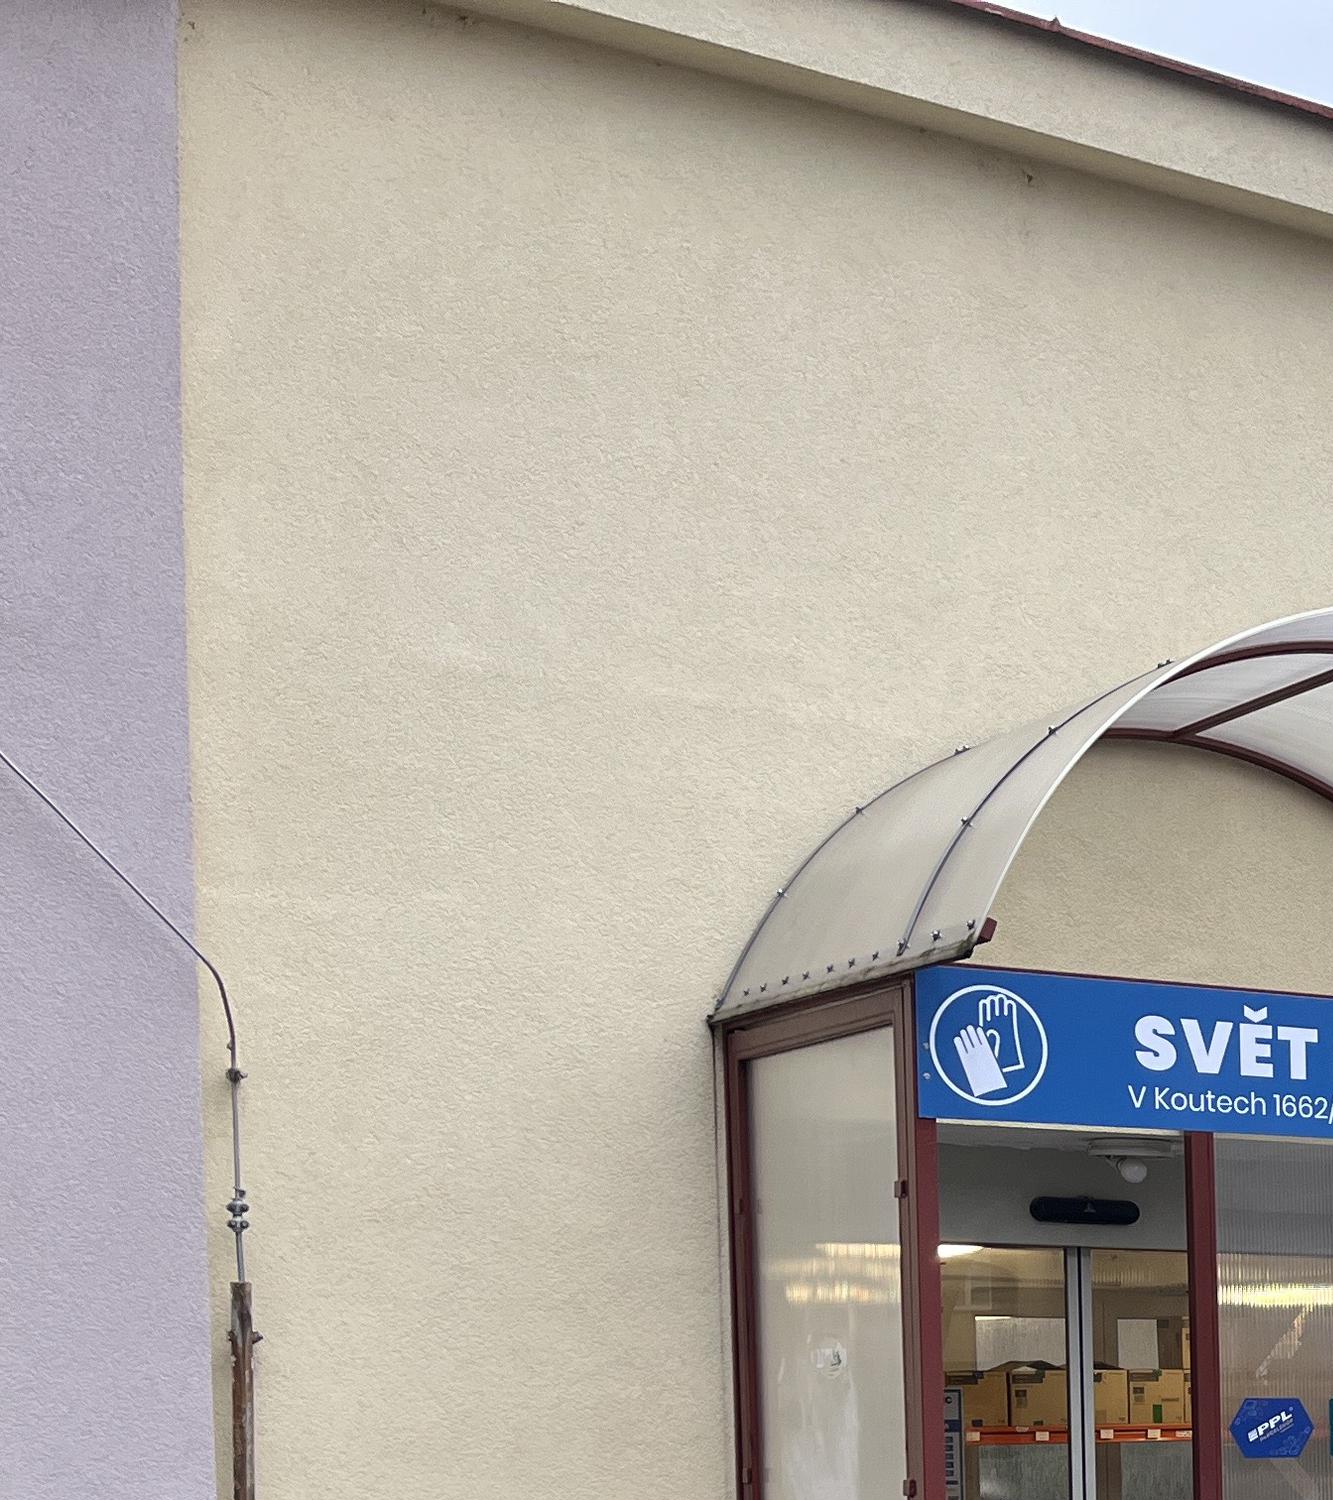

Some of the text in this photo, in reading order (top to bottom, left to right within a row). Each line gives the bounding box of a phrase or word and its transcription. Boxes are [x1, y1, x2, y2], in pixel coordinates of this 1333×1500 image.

[1134, 1004, 1319, 1080] SVĚT
[1127, 1086, 1147, 1108] V
[1154, 1086, 1267, 1116] Koutech
[1257, 1410, 1293, 1437] PPL
